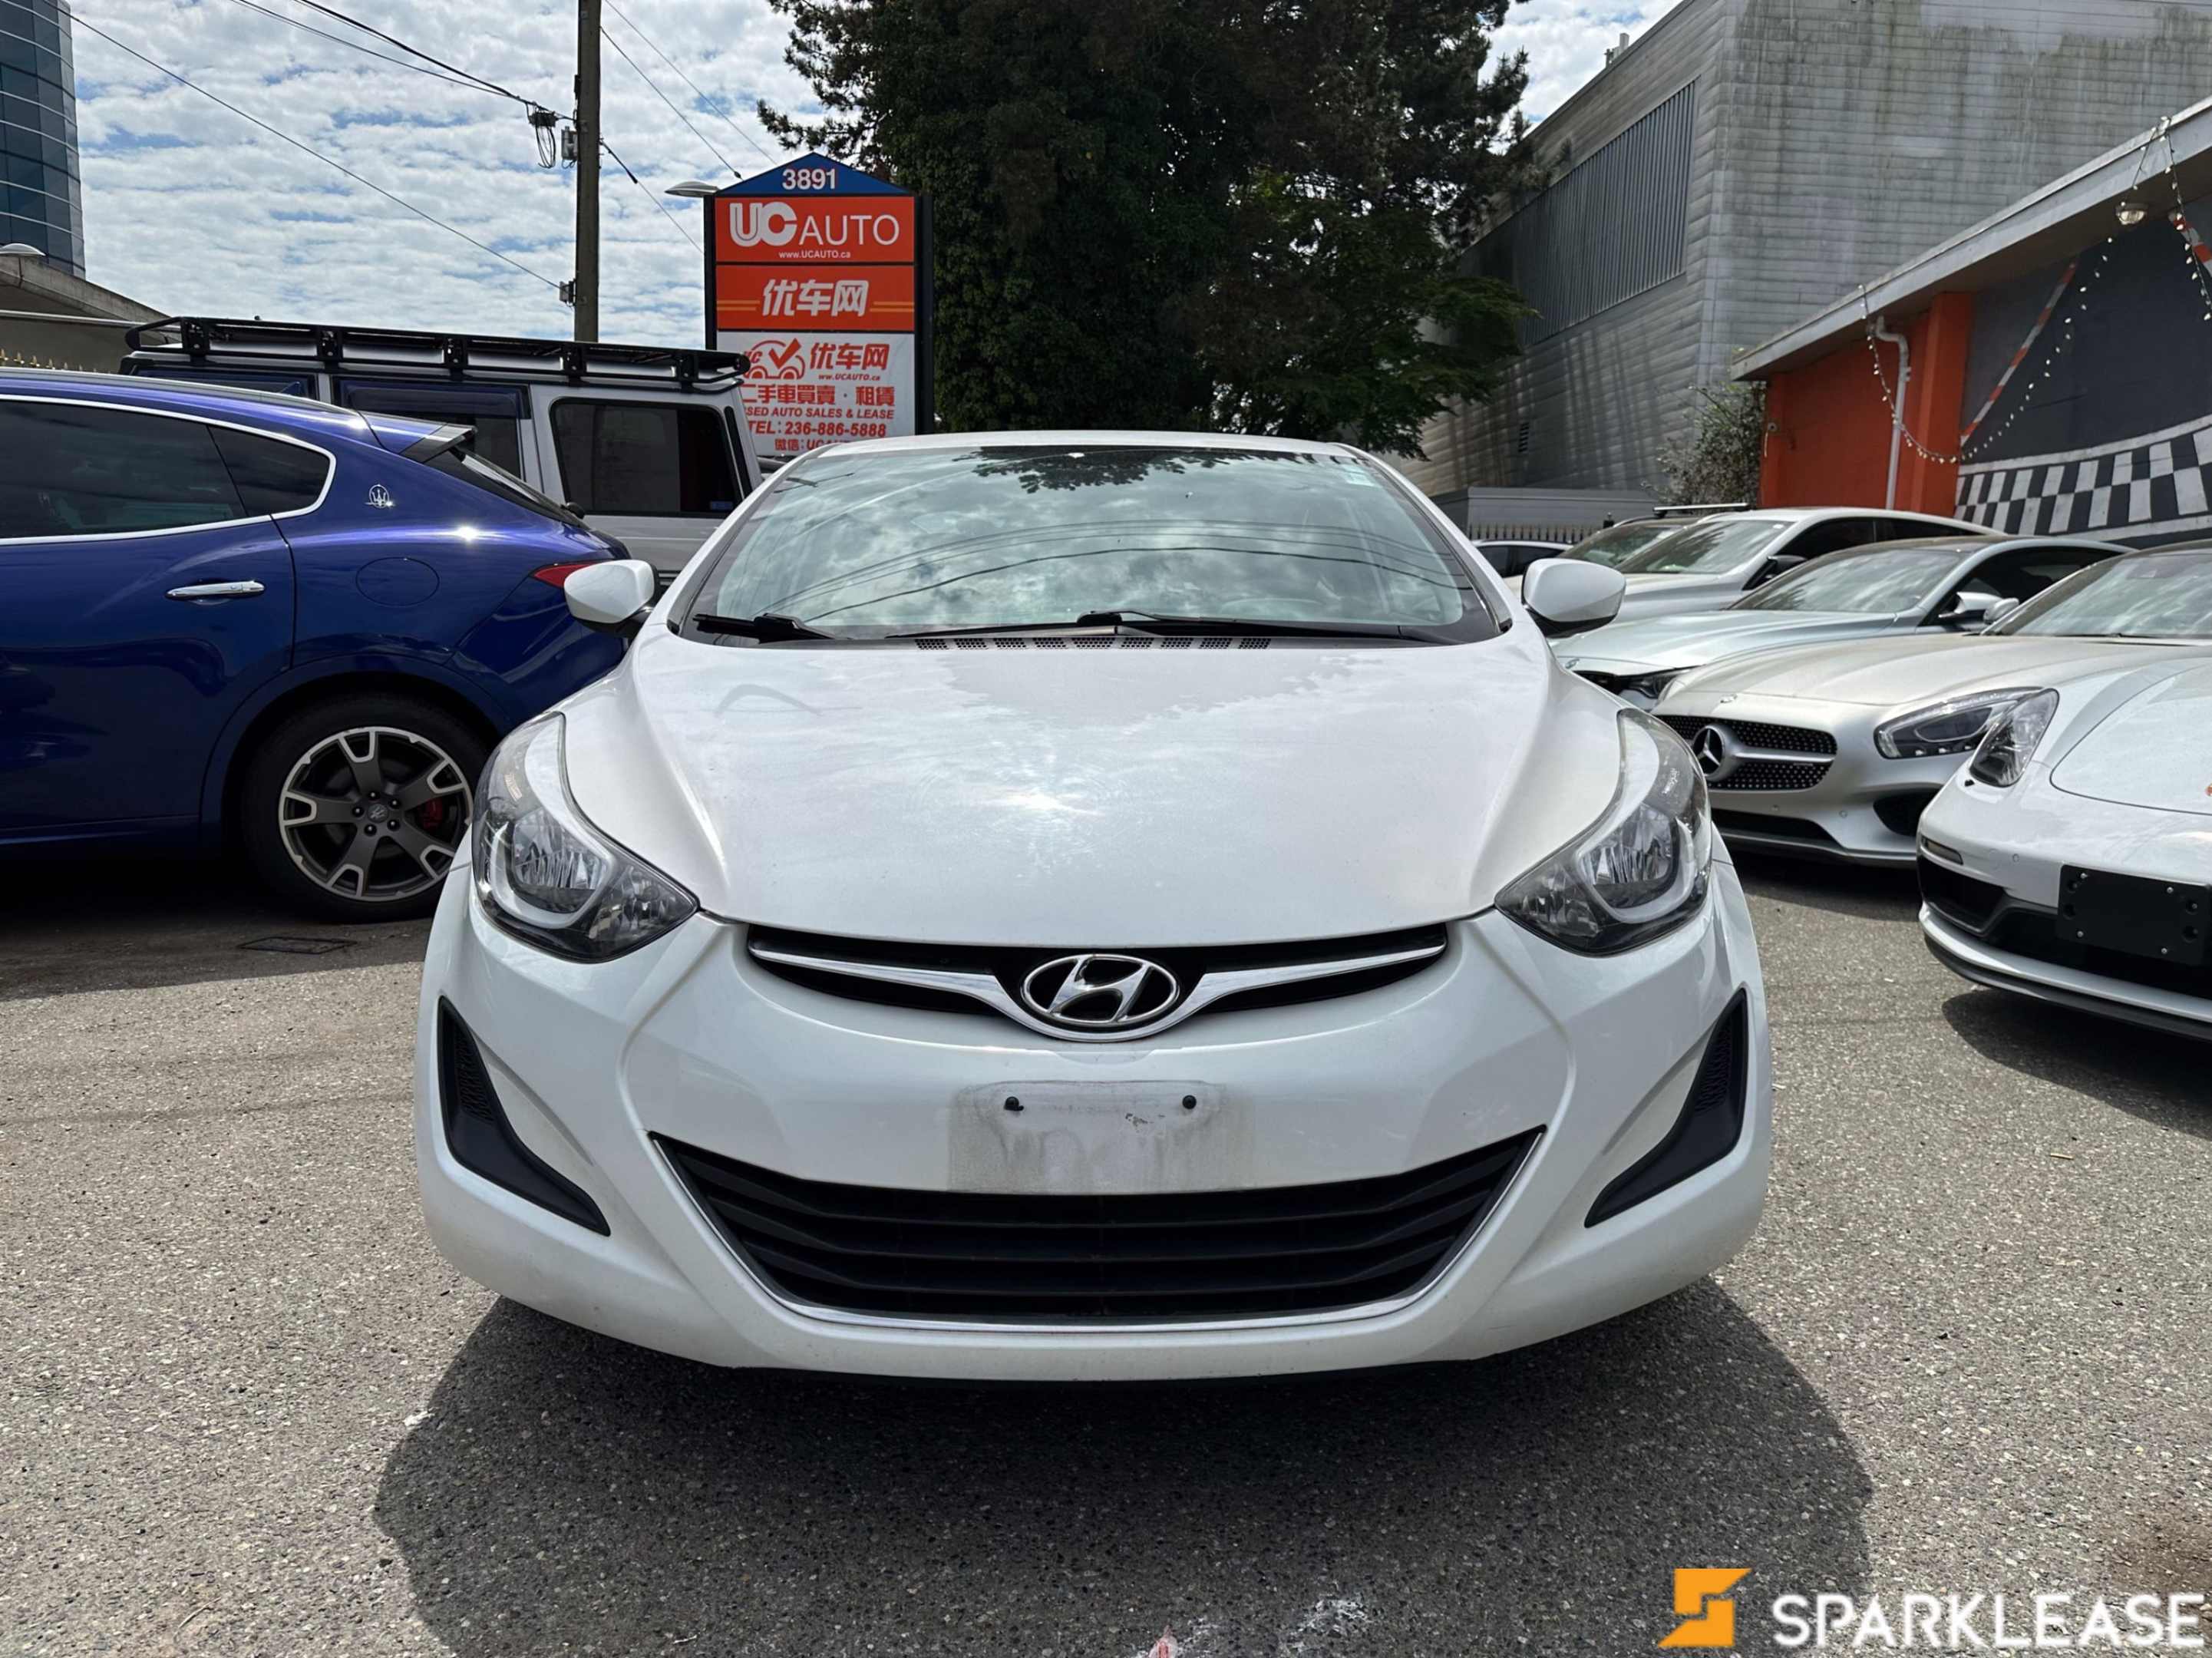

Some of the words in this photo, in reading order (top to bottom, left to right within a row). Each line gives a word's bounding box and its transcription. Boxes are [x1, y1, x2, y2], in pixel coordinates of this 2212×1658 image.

[782, 168, 836, 190] 3891
[778, 249, 851, 259] www.UCAUTO.ca
[762, 279, 869, 317] 优车网
[810, 342, 890, 370] 优车网
[744, 407, 769, 416] SED
[771, 407, 803, 417] AUTO
[806, 408, 842, 418] SALES
[846, 408, 853, 418] &
[857, 409, 895, 419] LEASE
[784, 422, 887, 438] 236-886-5888
